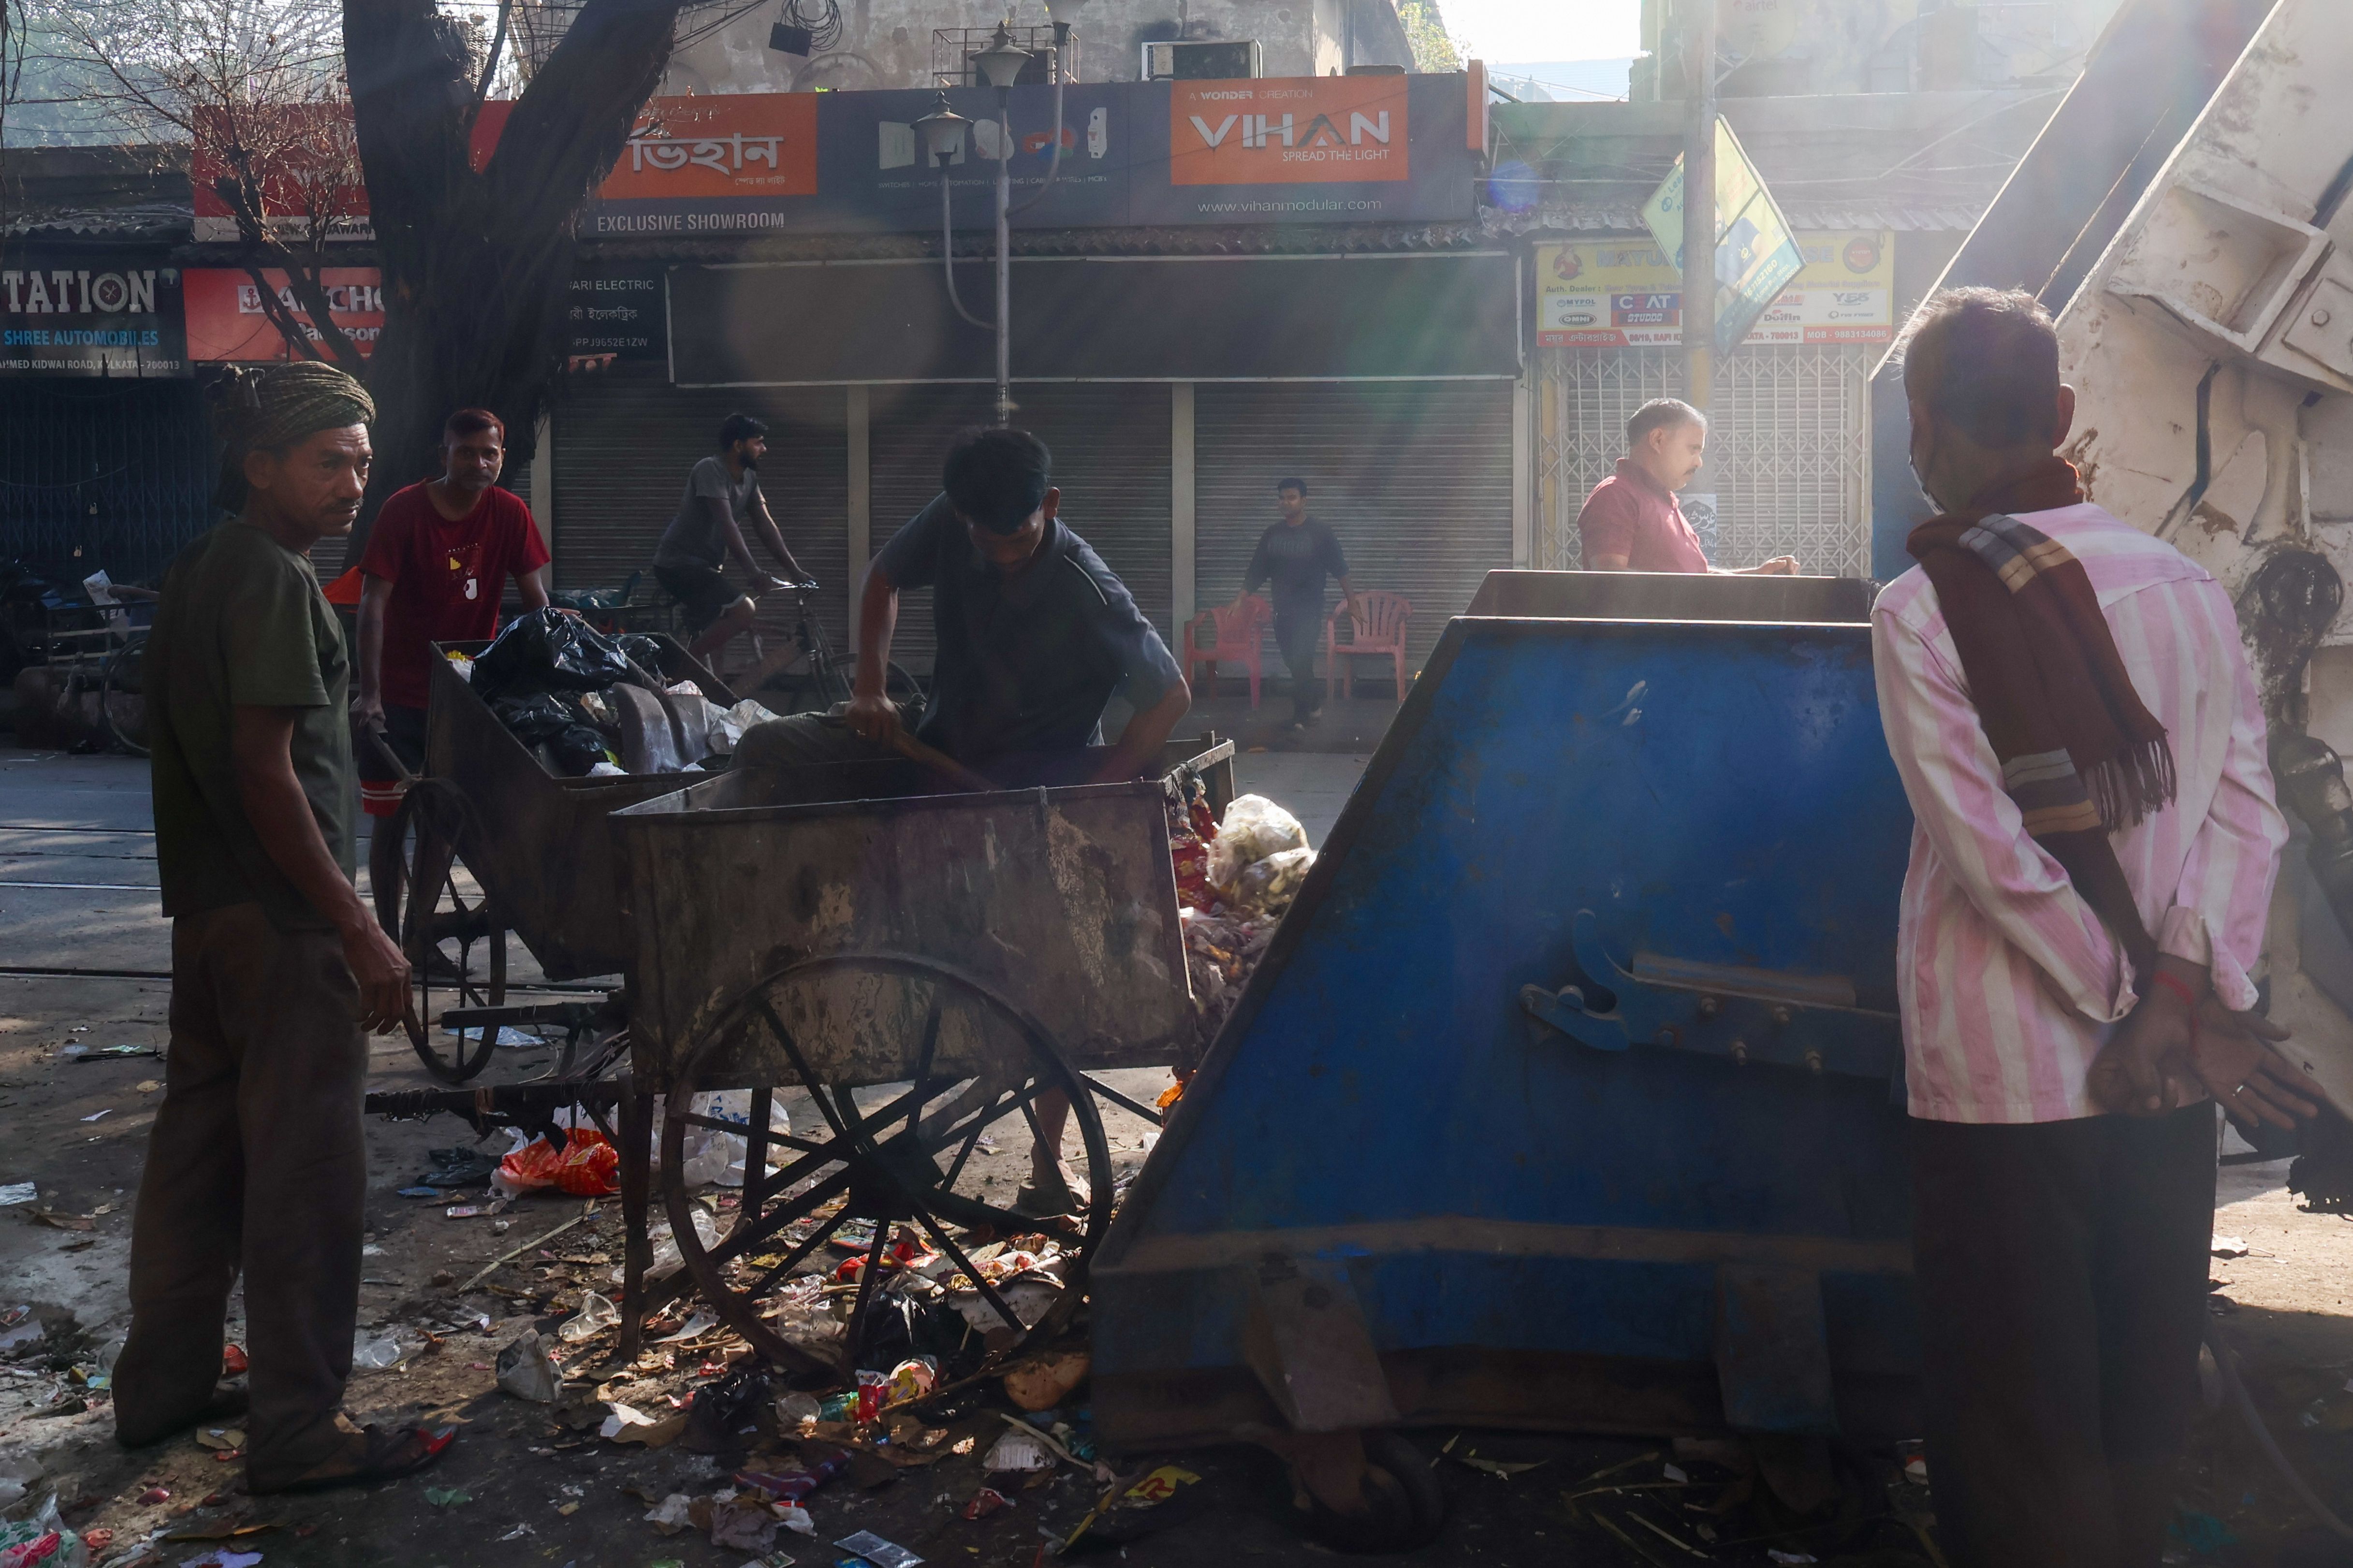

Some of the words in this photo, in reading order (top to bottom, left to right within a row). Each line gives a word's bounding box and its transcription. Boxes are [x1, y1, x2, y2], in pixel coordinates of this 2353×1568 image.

[1200, 90, 1253, 100] WONDER
[1259, 89, 1313, 99] CREATION
[1189, 111, 1389, 149] VIHAN
[626, 127, 784, 175] ভিহান
[1282, 150, 1326, 161] SPREAD
[1328, 150, 1351, 161] THE
[1355, 149, 1389, 160] LIGHT
[1198, 199, 1382, 212] www.vihanmodular.com
[598, 215, 682, 232] EXCLUSIVE
[687, 213, 785, 230] SHOWROOM
[596, 280, 654, 290] ELECTRIC
[4, 330, 50, 346] SHREE
[54, 330, 159, 346] AUTOMOBILES
[1835, 330, 1887, 338] 9883134086
[32, 360, 66, 369] KIDWAI
